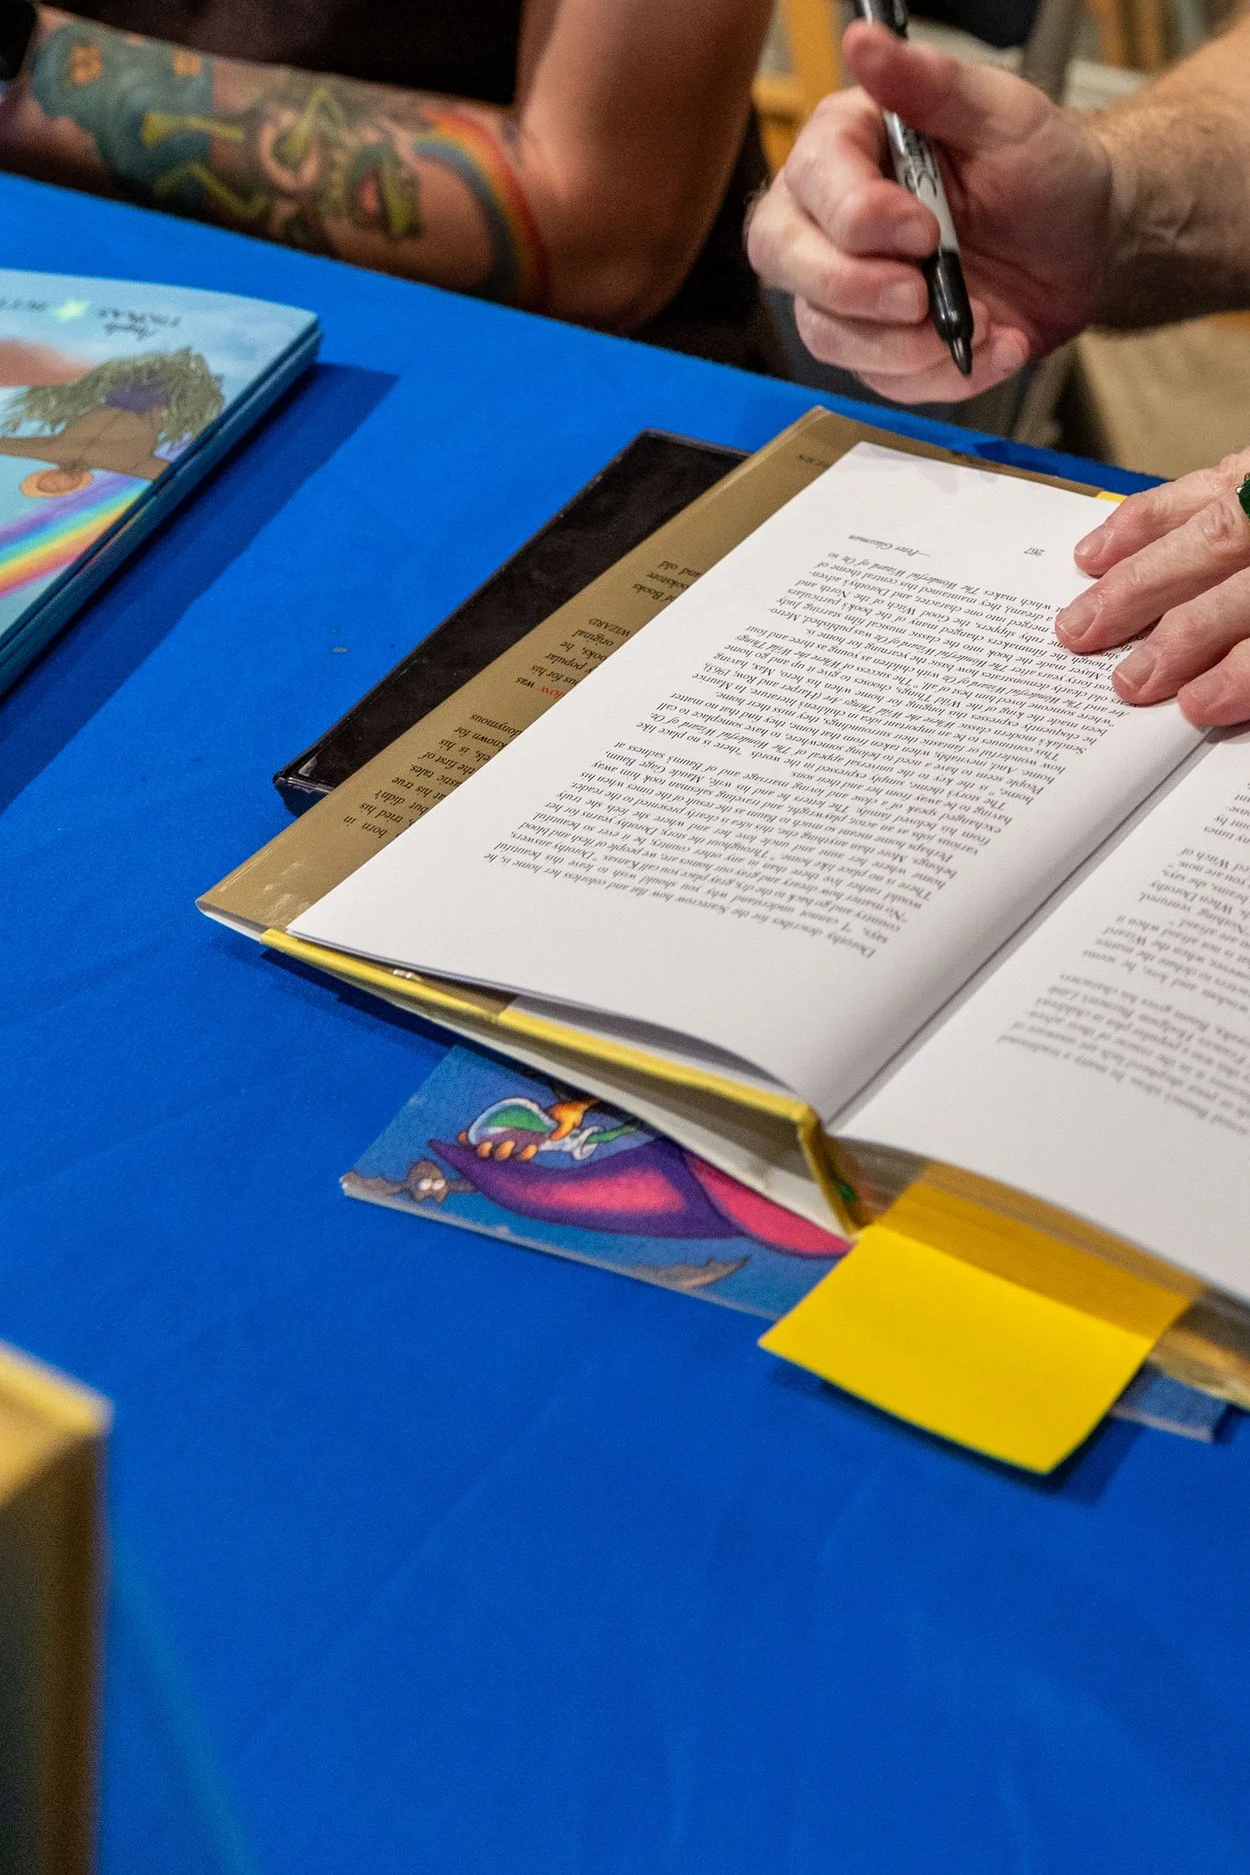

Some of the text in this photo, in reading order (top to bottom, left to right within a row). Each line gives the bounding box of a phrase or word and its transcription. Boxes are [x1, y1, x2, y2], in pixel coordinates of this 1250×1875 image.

[848, 535, 893, 550] Glassman
[1023, 546, 1046, 558] 267
[657, 560, 679, 572] old
[646, 572, 691, 590] ookstore
[631, 583, 665, 601] Books
[787, 588, 842, 606] particulars
[841, 603, 873, 616] book's
[875, 611, 893, 620] the
[587, 616, 632, 639] WIZARD
[908, 618, 938, 630] many
[572, 628, 615, 650] original
[938, 627, 985, 642] changed
[581, 646, 609, 661] ooks,
[724, 644, 754, 658] home
[987, 638, 1048, 658] filmmakers
[544, 652, 589, 672] popular
[766, 656, 790, 665] and
[1049, 652, 1068, 662] the
[1071, 655, 1113, 671] Though
[530, 665, 564, 683] for his
[703, 662, 731, 677] 1963),
[816, 668, 842, 678] give
[733, 670, 758, 684] Row,
[756, 678, 780, 687] and
[515, 676, 565, 700] low was
[854, 678, 892, 692] chooses
[716, 691, 746, 706] home.
[822, 695, 843, 704] Are
[896, 687, 932, 703] Things,
[746, 700, 772, 712] their
[842, 699, 876, 714] Things
[933, 696, 961, 708] Wild
[965, 702, 984, 712] the
[772, 707, 797, 717] miss
[796, 711, 820, 724] they
[875, 708, 904, 719] Wild
[904, 713, 923, 722] the
[998, 707, 1025, 720] king
[1026, 713, 1045, 723] the
[469, 714, 521, 737] donymous
[636, 722, 658, 734] like
[823, 718, 892, 737] surroundings,
[922, 717, 956, 729] Where
[957, 723, 992, 735] classic
[1046, 718, 1079, 728] made
[658, 728, 688, 740] place
[993, 729, 1037, 742] modern
[1080, 724, 1107, 737] been
[453, 726, 507, 750] known for
[893, 733, 919, 744] their
[438, 738, 456, 752] his
[919, 739, 965, 753] fantastic
[1038, 739, 1083, 754] Sendak's
[434, 755, 458, 770] first
[605, 751, 637, 767] Baum,
[751, 751, 781, 762] words
[783, 758, 802, 768] the
[978, 750, 1037, 766] wonderful
[410, 764, 435, 780] tales.
[457, 763, 476, 775] the
[638, 761, 666, 774] Gage
[814, 765, 867, 779] expressed
[1040, 763, 1065, 775] how
[668, 769, 705, 784] Maude
[709, 777, 732, 788] wife,
[871, 775, 904, 786] simply
[391, 777, 434, 798] his true
[736, 784, 752, 794] his
[750, 787, 775, 796] and
[909, 781, 945, 796] theme,
[373, 790, 429, 814] but didn't
[946, 790, 980, 801] story's
[794, 796, 827, 809] letters
[828, 803, 849, 814] The
[983, 798, 1005, 810] The
[359, 802, 404, 824] tried his
[857, 807, 892, 820] family.
[892, 815, 937, 831] beloved
[361, 822, 389, 839] born
[941, 826, 958, 836] his
[961, 831, 991, 845] from
